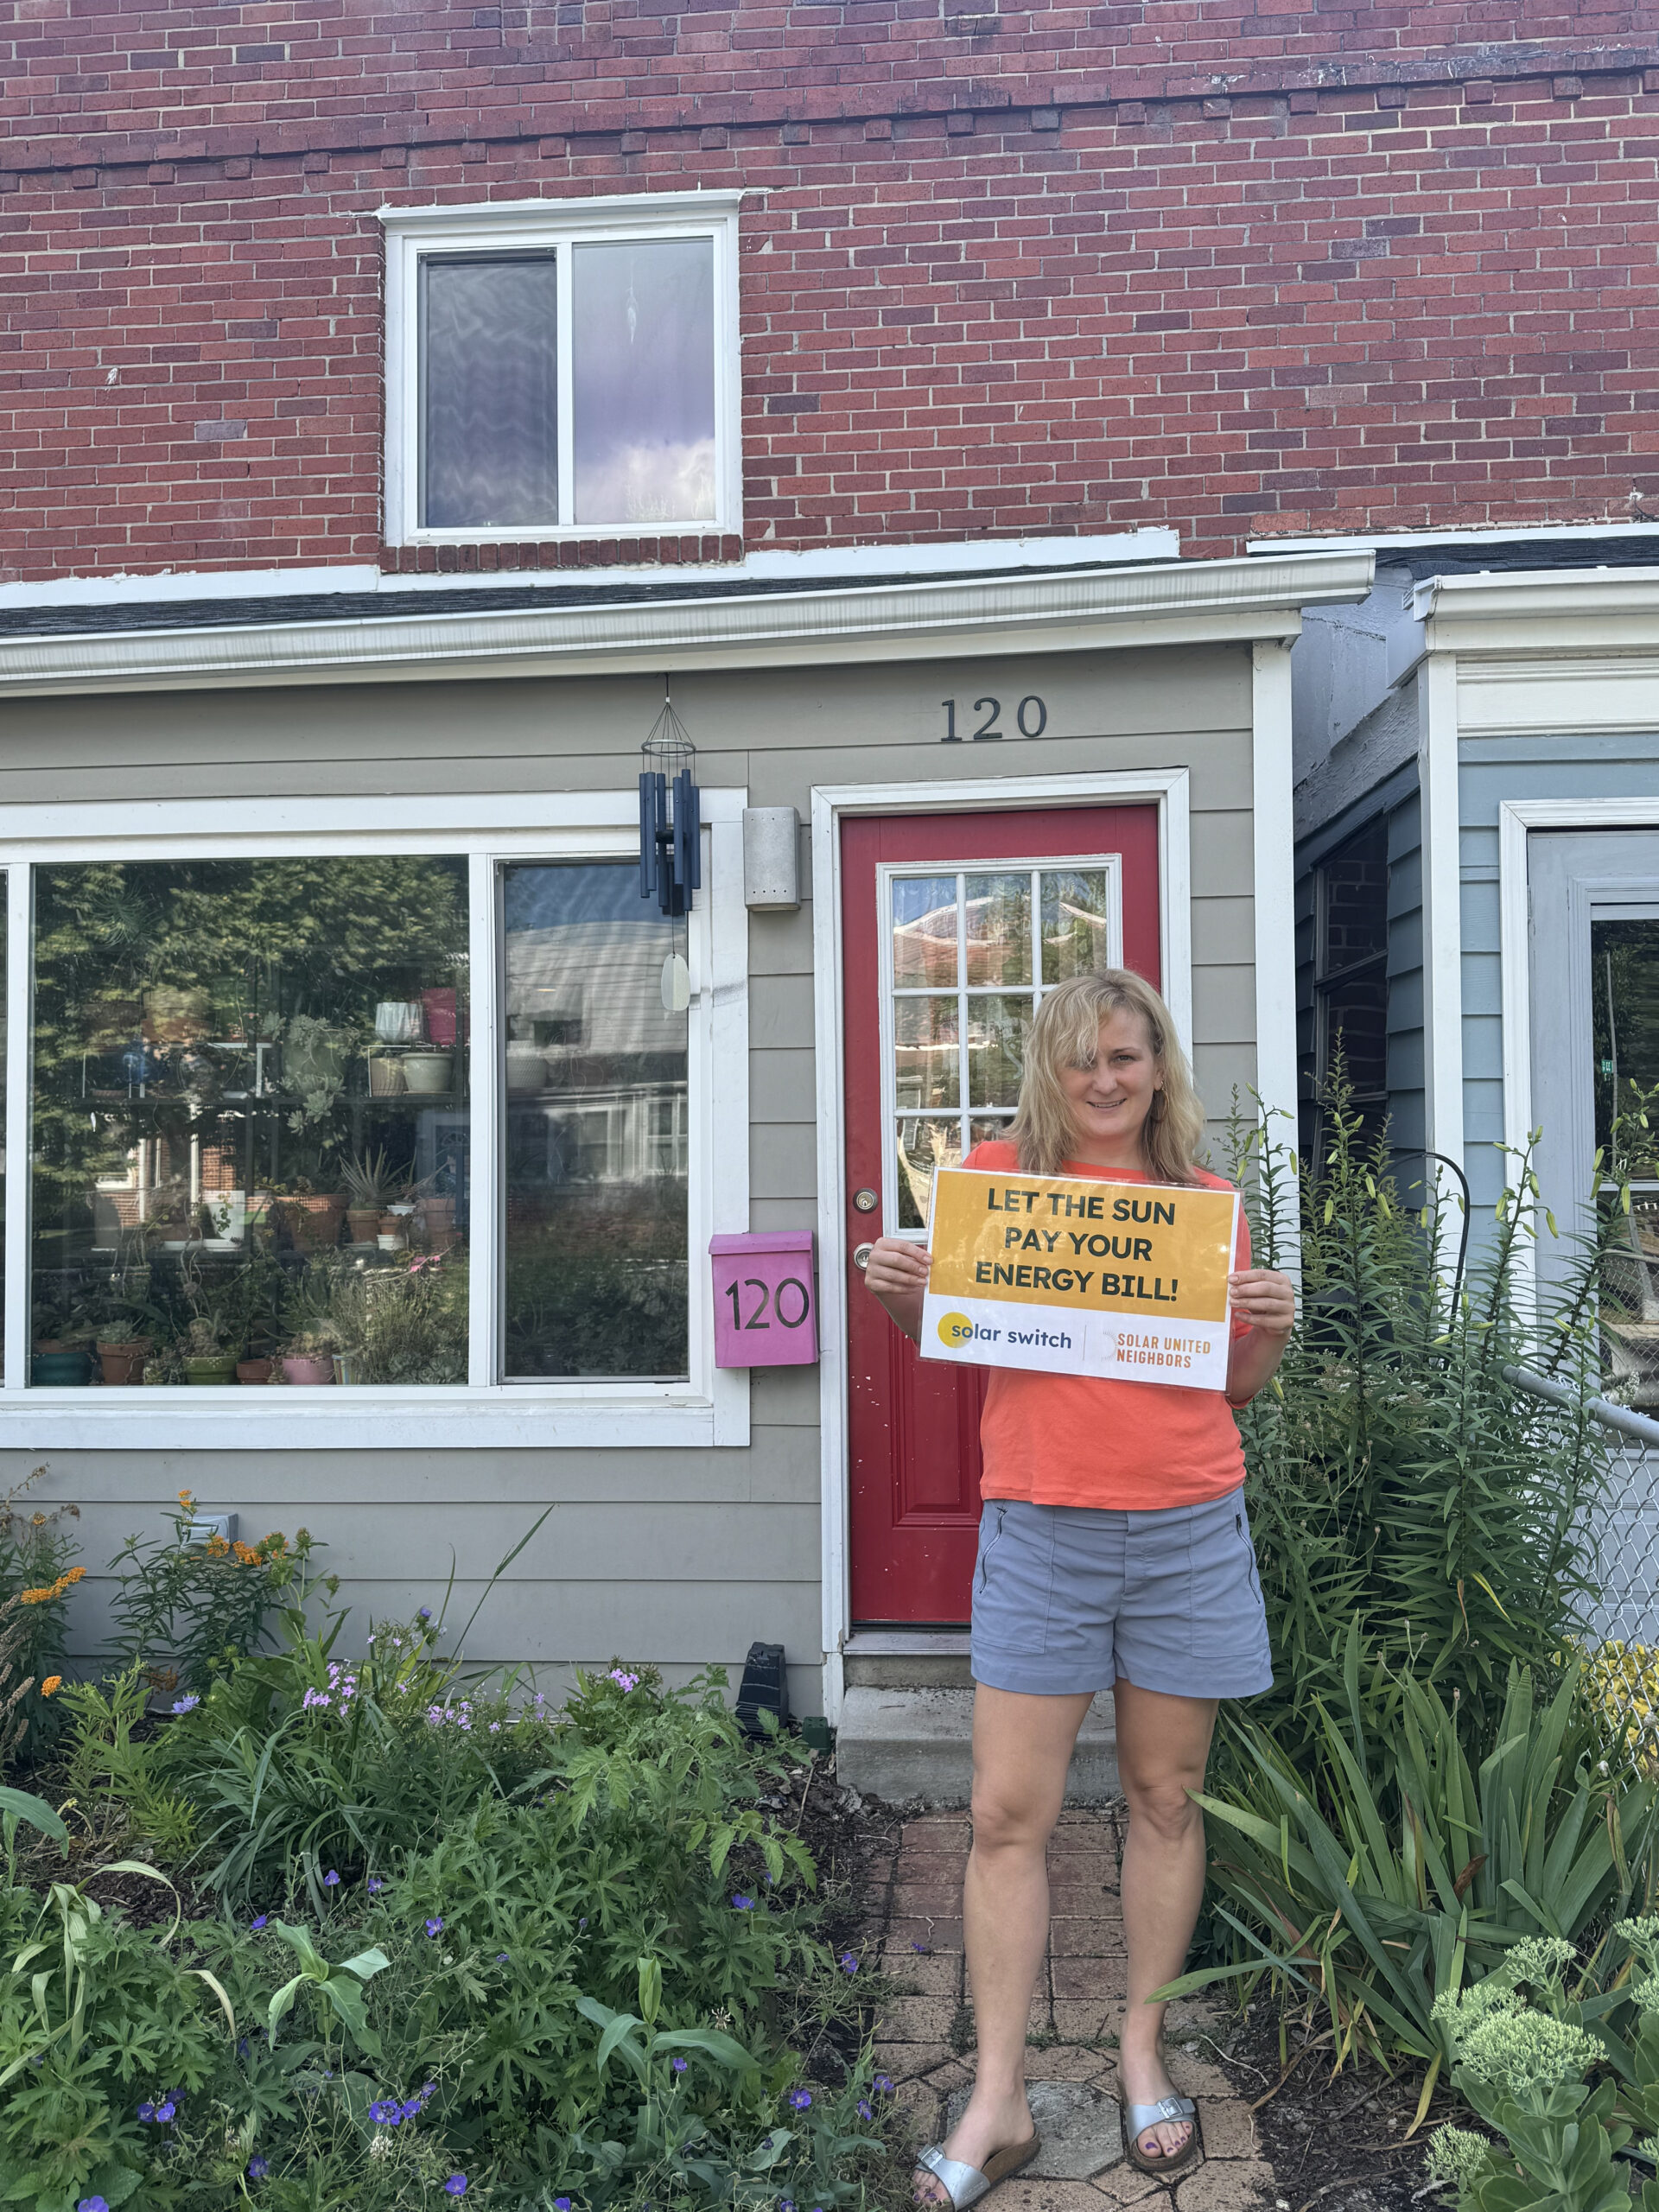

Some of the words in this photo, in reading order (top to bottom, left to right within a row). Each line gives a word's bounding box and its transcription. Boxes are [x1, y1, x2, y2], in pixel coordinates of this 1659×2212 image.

[941, 696, 1047, 741] 120
[988, 1188, 1039, 1213] LET
[1047, 1193, 1104, 1219] THE
[1112, 1199, 1175, 1225] SUN
[1005, 1227, 1062, 1252] PAY
[1069, 1233, 1152, 1262] YOUR
[976, 1262, 1094, 1293] ENERGY
[1102, 1273, 1178, 1301] BILL!
[725, 1278, 809, 1330] 120
[951, 1323, 1001, 1341] solar
[1007, 1329, 1071, 1349] switch
[1118, 1332, 1159, 1350] SOLAR
[1164, 1337, 1211, 1354] UNITED
[1116, 1349, 1191, 1368] NEIGHBORS
